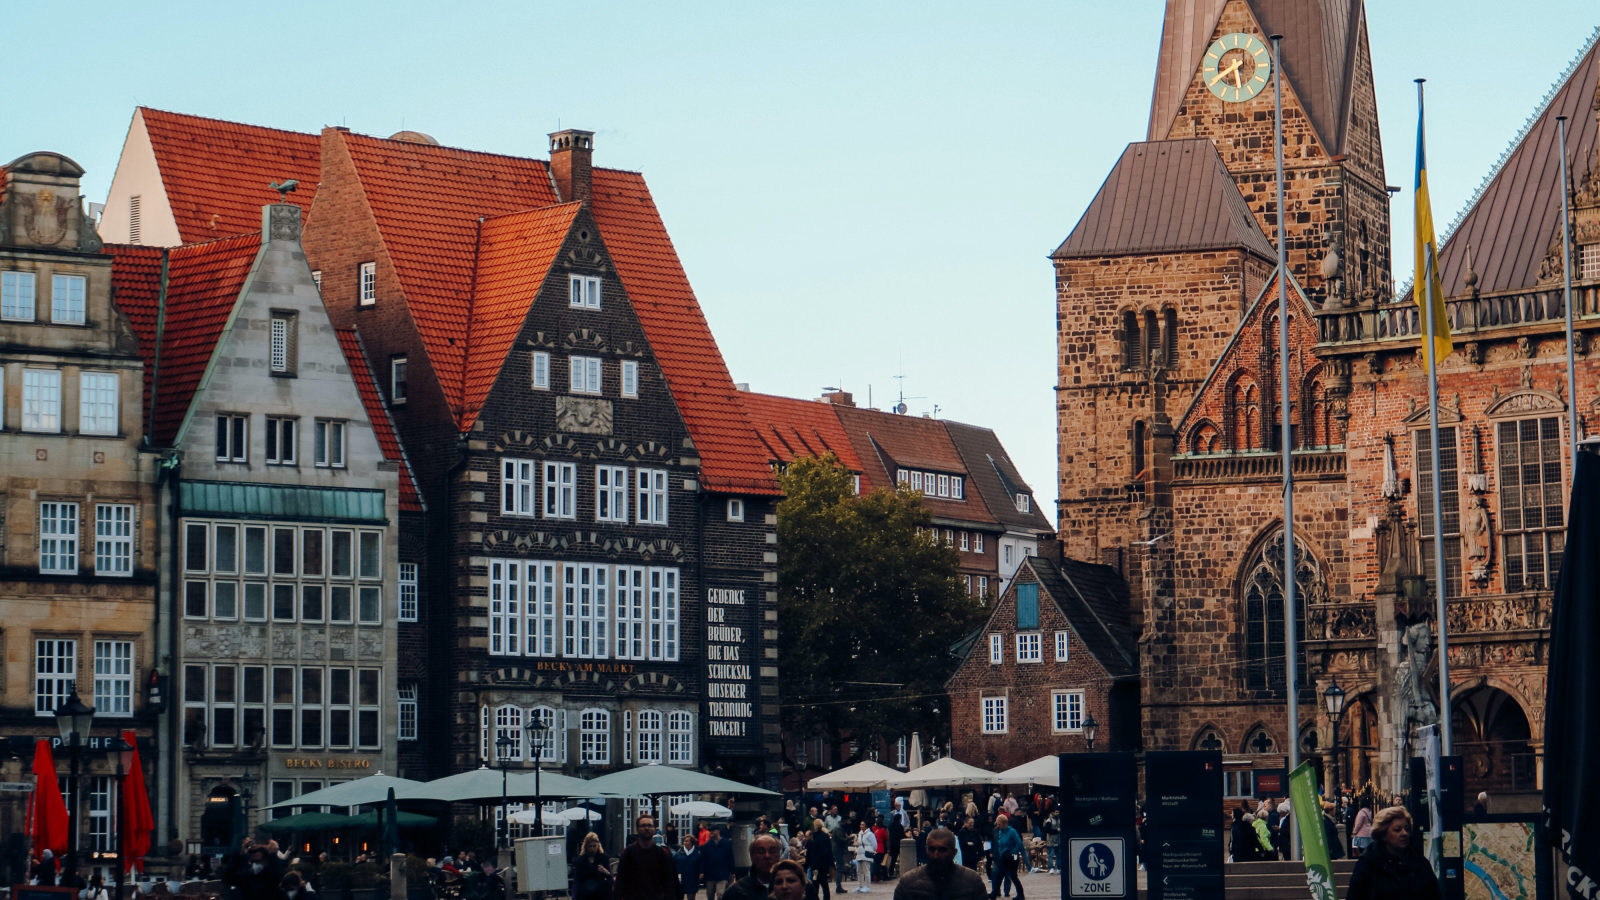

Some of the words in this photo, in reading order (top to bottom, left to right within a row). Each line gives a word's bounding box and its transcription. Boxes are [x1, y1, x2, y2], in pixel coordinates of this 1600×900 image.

[708, 588, 745, 605] GEDENKE
[707, 607, 725, 622] DER
[707, 624, 746, 643] BRÜDER,
[708, 645, 721, 660] DIE
[723, 646, 740, 661] DAS
[575, 663, 593, 672] AM
[597, 664, 635, 673] MARKT
[708, 664, 752, 680] SCHICKSAL
[708, 683, 746, 699] UNSERER
[708, 702, 752, 718] TRENNUNG
[328, 758, 370, 769] BISTRO
